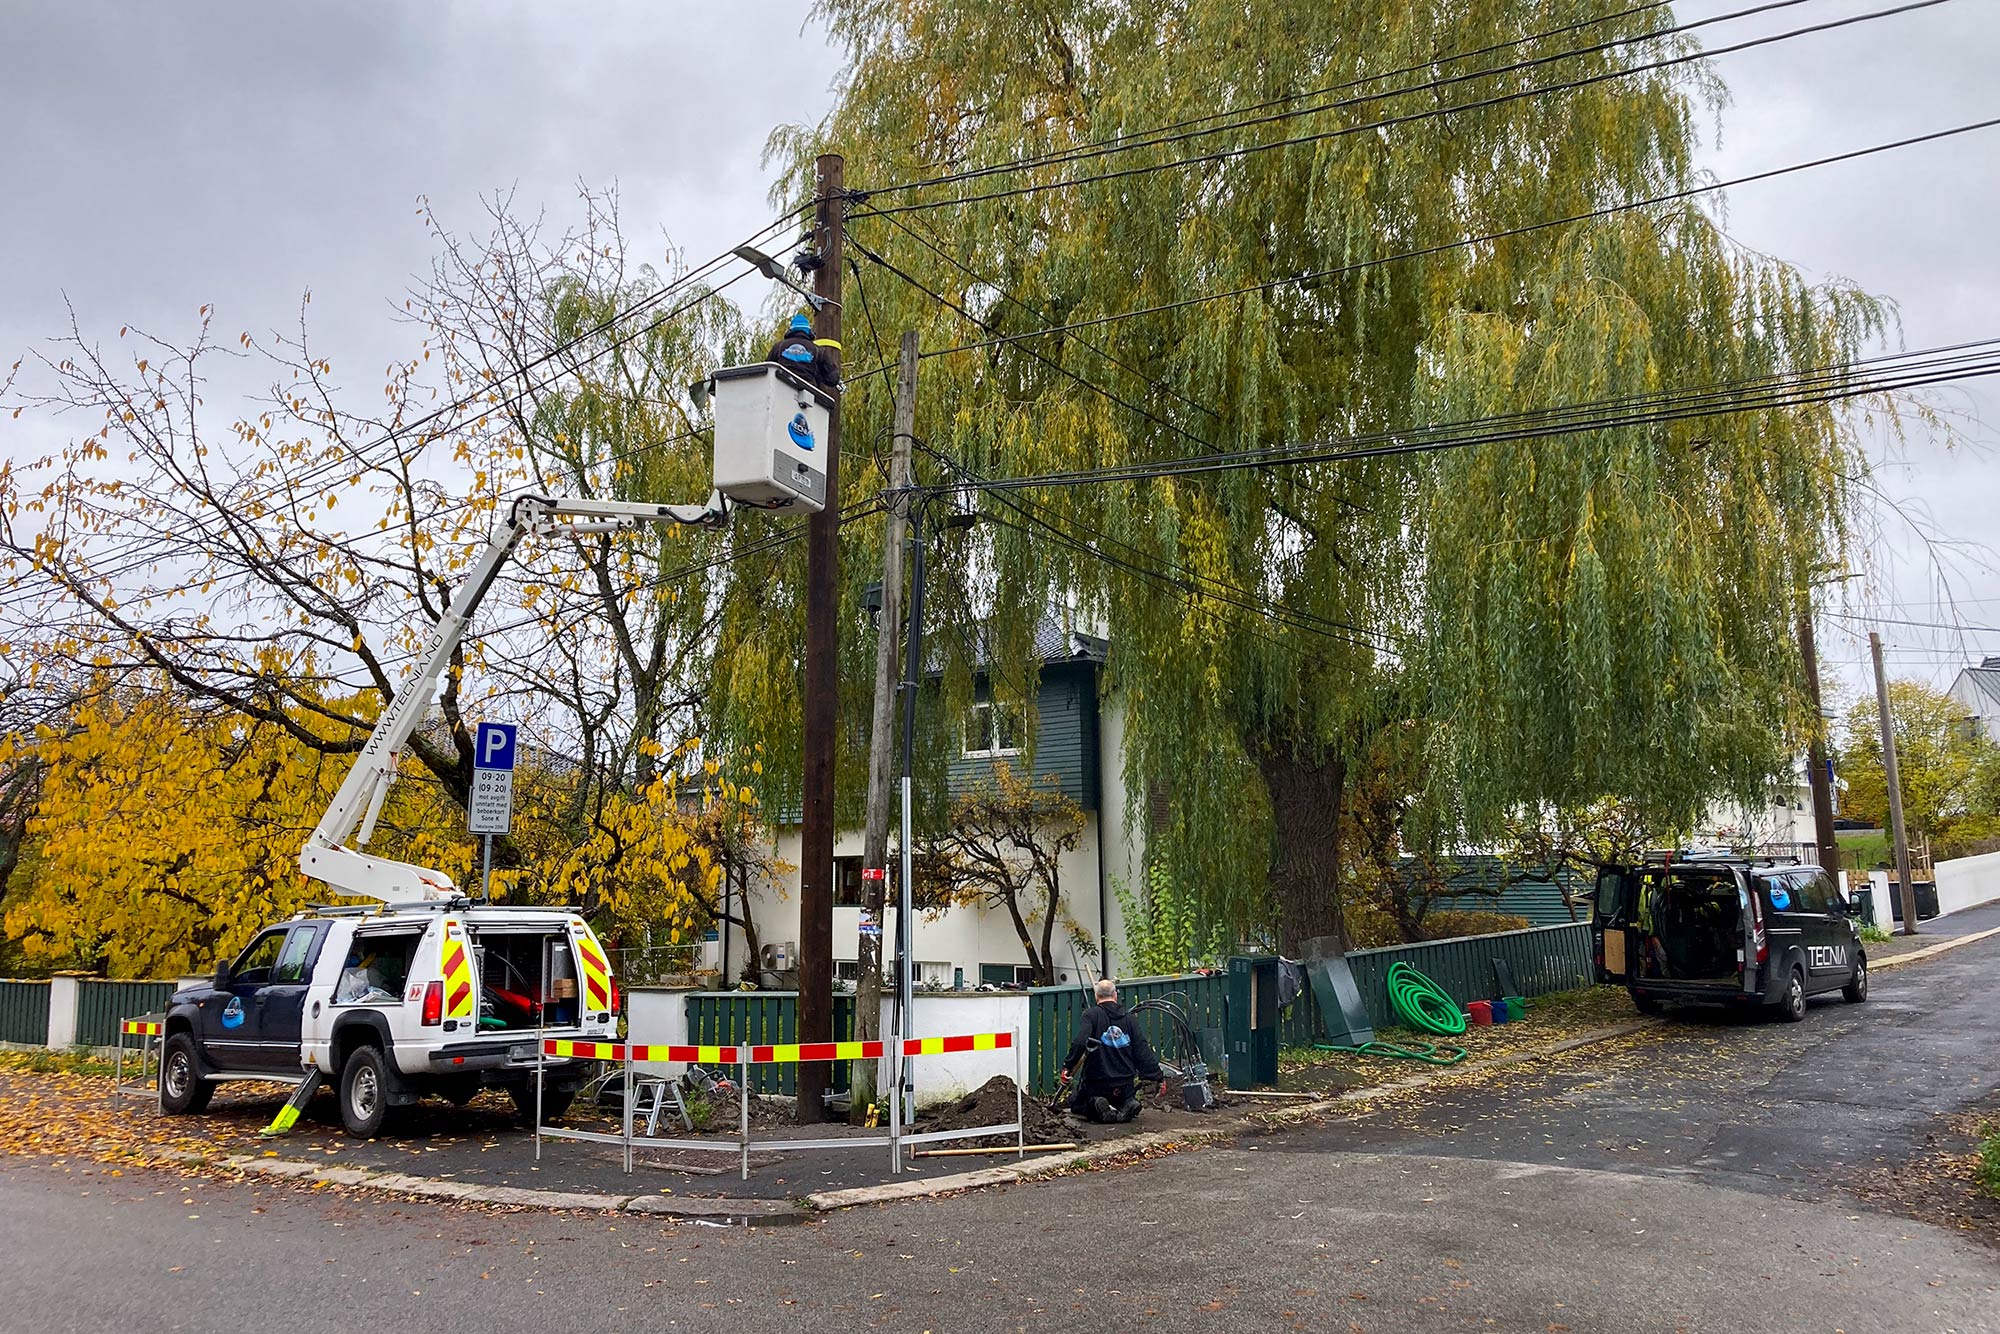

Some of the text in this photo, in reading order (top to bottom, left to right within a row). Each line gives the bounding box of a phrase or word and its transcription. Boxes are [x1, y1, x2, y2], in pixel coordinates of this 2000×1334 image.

[366, 634, 443, 756] WWW.TECNIA.NO
[485, 728, 507, 763] P
[1807, 945, 1847, 966] TECNIA
